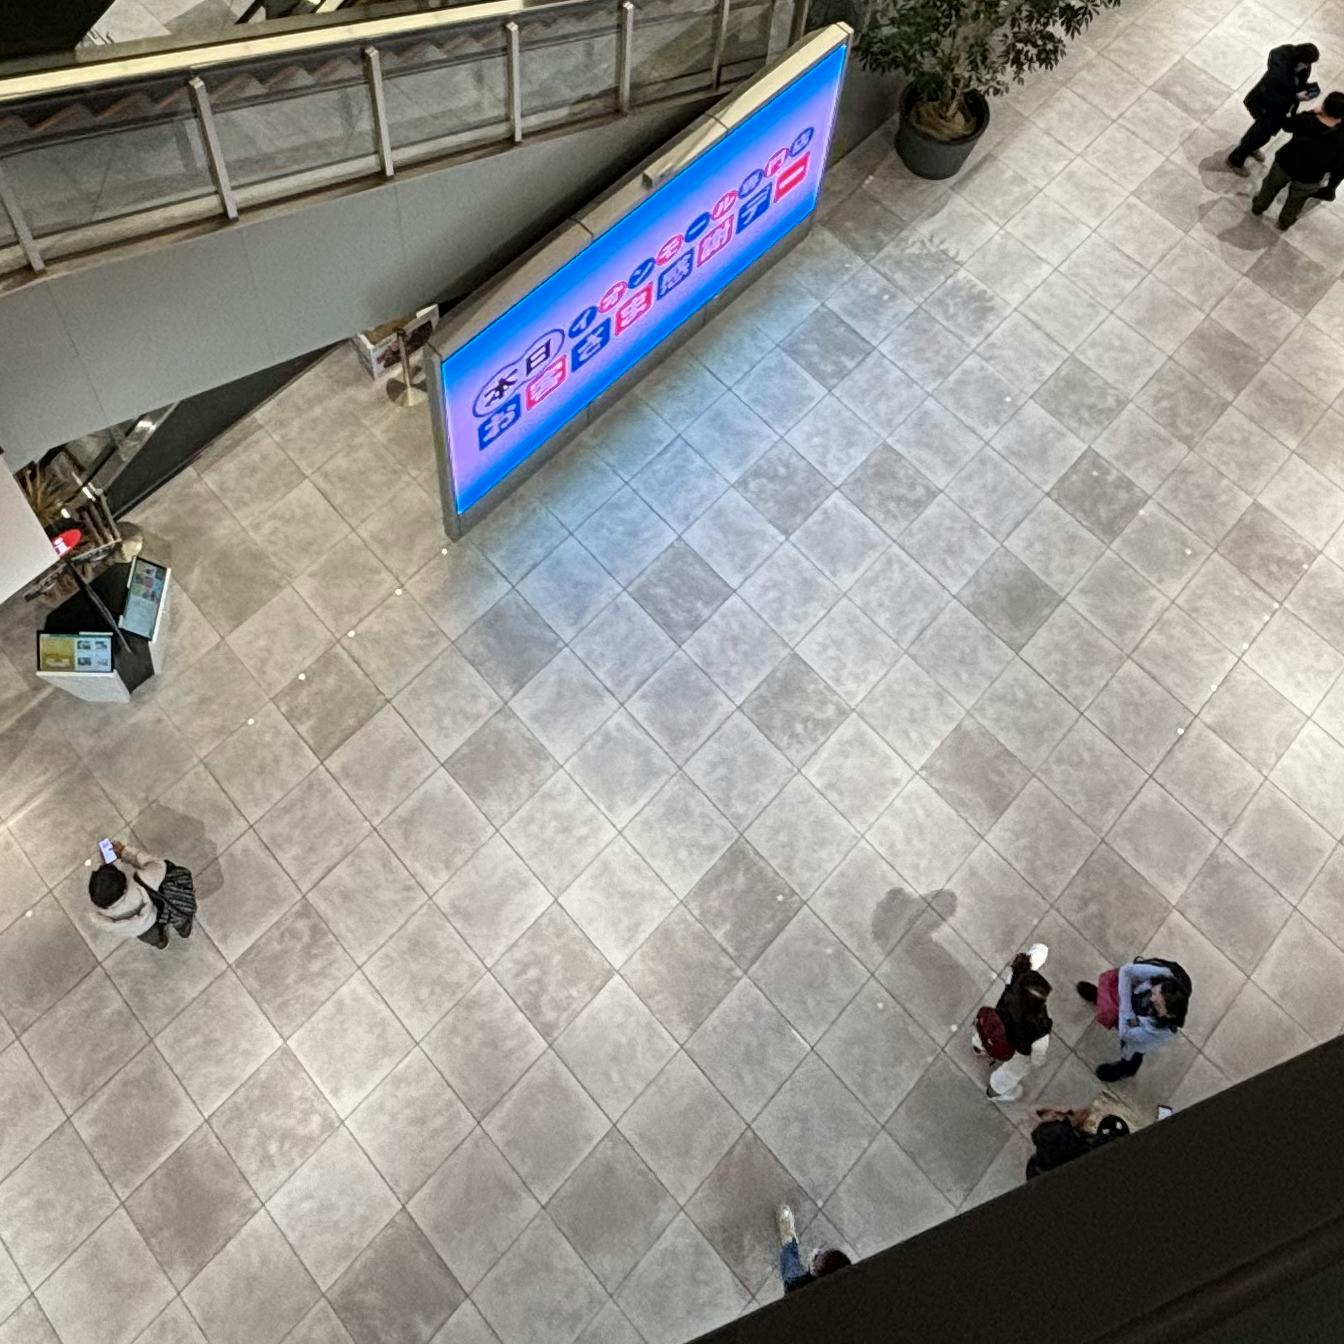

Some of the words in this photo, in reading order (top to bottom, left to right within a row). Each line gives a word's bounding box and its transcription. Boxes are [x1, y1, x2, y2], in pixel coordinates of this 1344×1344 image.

[480, 156, 809, 447] お客さま感謝デー
[483, 338, 552, 408] 本日
